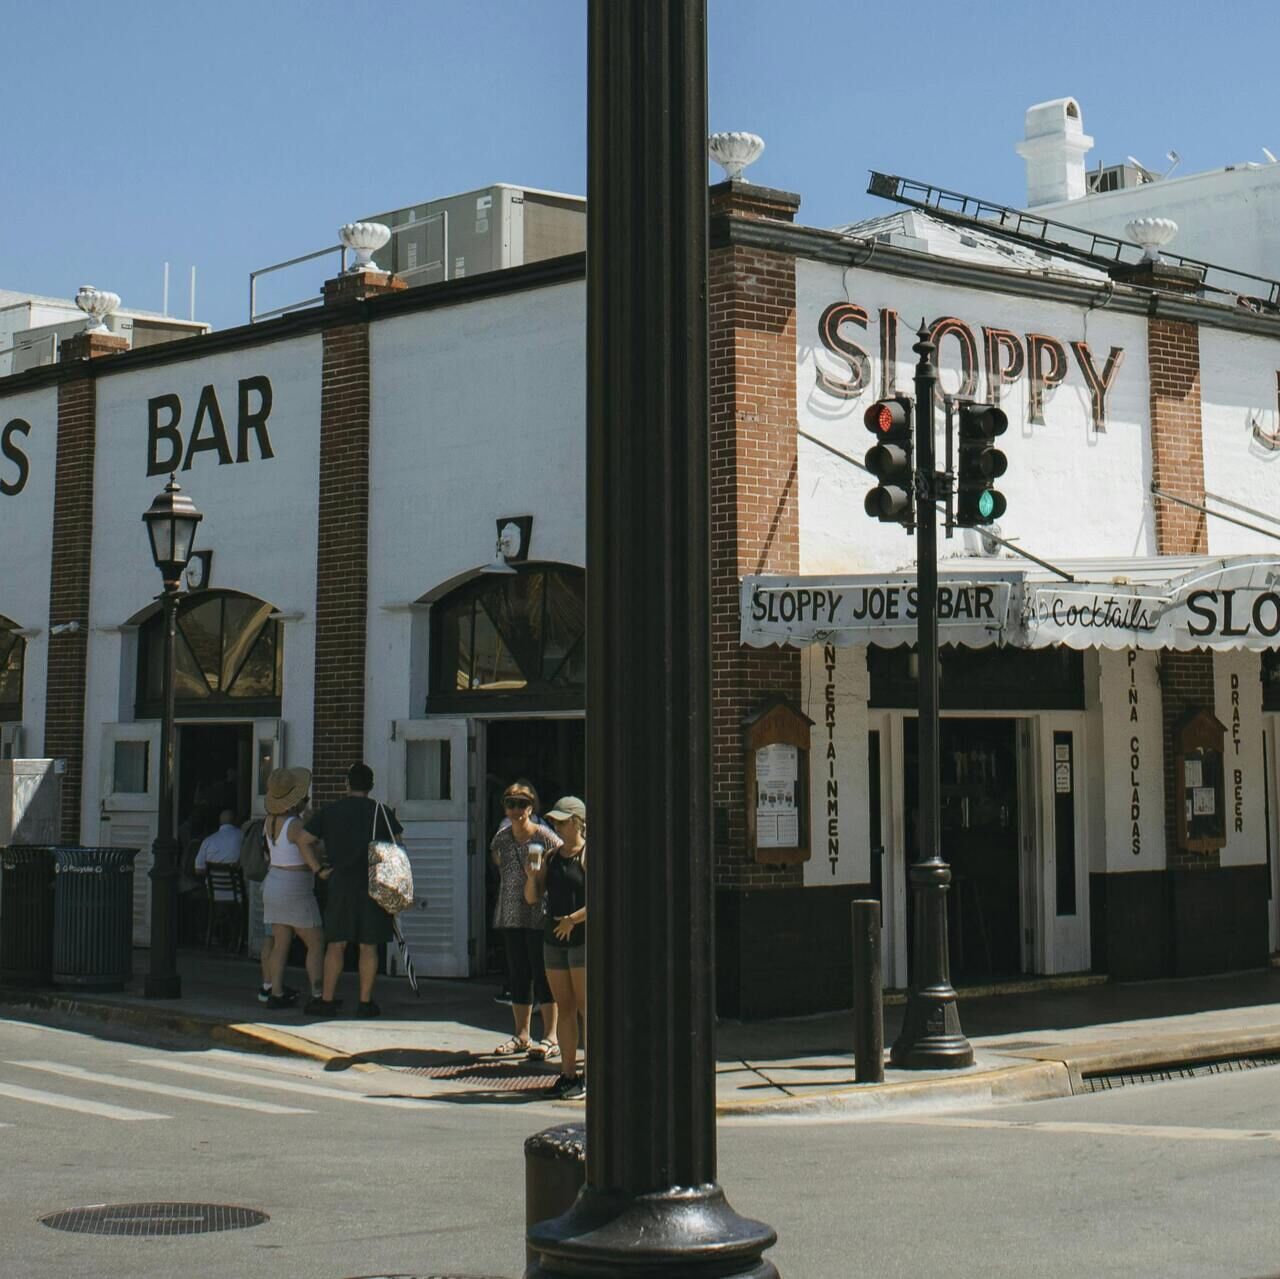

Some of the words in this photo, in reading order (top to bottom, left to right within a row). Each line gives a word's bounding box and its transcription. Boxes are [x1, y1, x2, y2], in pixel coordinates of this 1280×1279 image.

[815, 300, 1124, 434] SLOPPY
[145, 375, 276, 477] BAR
[751, 589, 843, 623] SLOPPY
[853, 584, 919, 620] JOE'S
[936, 586, 995, 619] BAR
[1052, 595, 1157, 631] Cocktails
[823, 643, 839, 876] NTERTAINMENT
[1230, 673, 1241, 757] DRAFT
[1129, 736, 1141, 856] COLADAS
[1233, 769, 1243, 833] BEER
